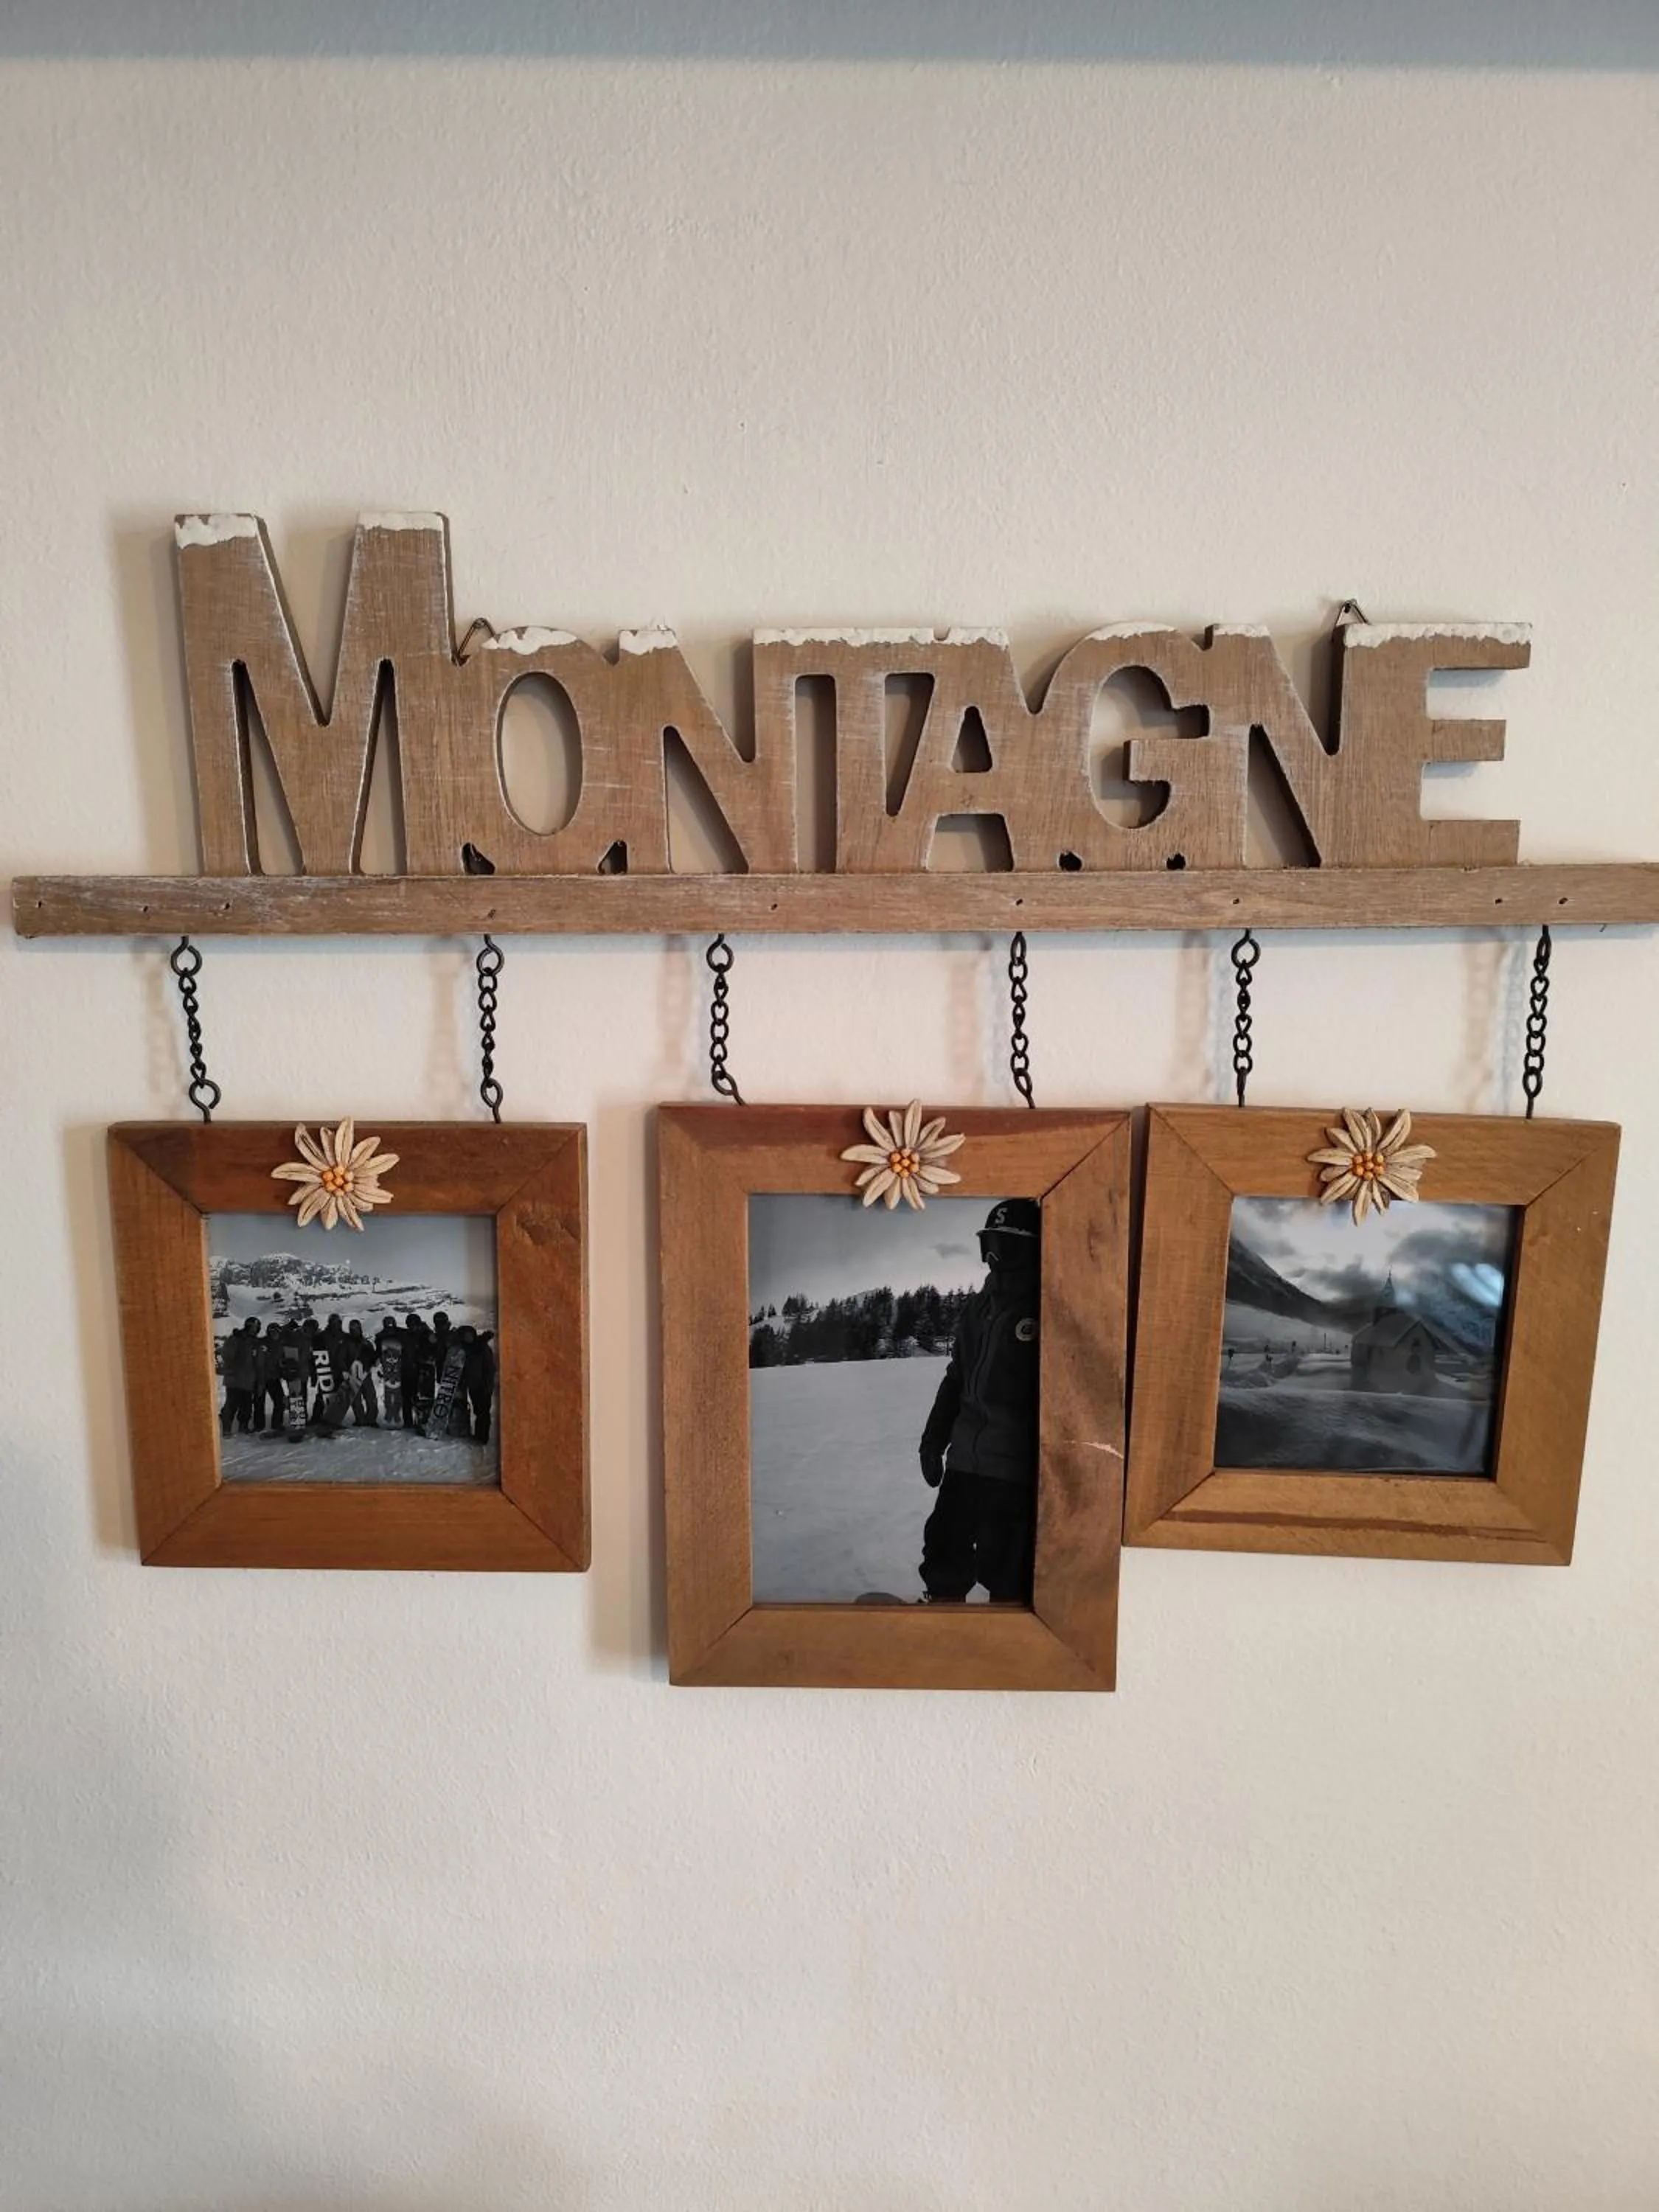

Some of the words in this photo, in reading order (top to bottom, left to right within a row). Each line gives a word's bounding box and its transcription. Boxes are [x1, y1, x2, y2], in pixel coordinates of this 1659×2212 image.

[174, 512, 1532, 876] MONTAGNE
[995, 1207, 1008, 1225] S
[434, 1366, 462, 1417] NITRO
